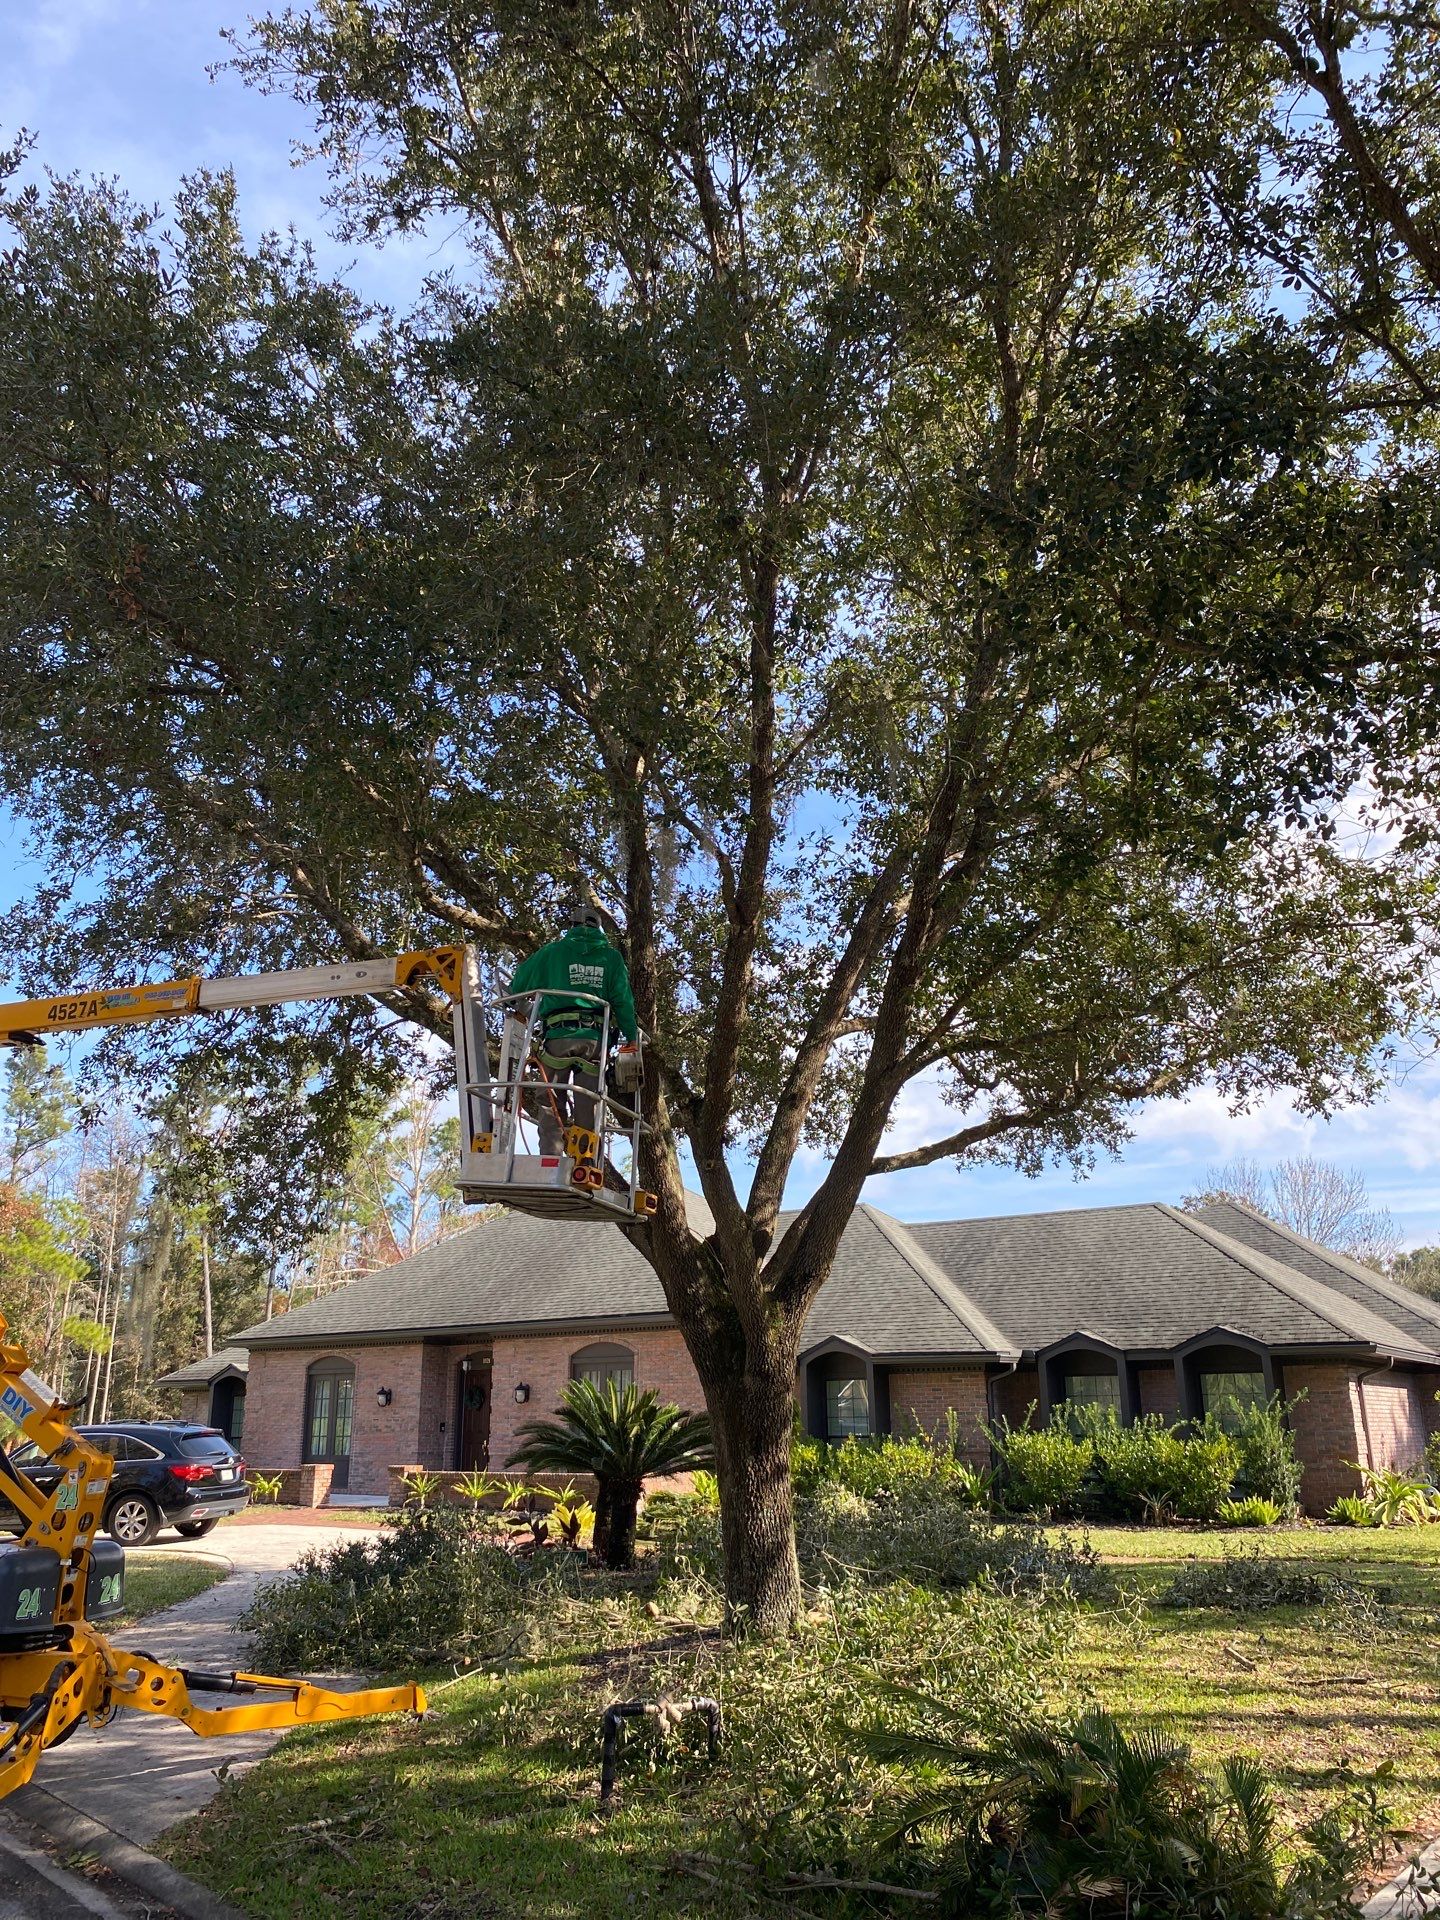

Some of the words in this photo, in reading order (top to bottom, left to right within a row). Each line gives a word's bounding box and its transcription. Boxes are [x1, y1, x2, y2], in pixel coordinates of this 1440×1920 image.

[48, 1000, 97, 1021] 4527A
[2, 1386, 35, 1418] DIY
[55, 1484, 79, 1510] 24
[15, 1587, 41, 1620] 24
[98, 1573, 121, 1605] 24
